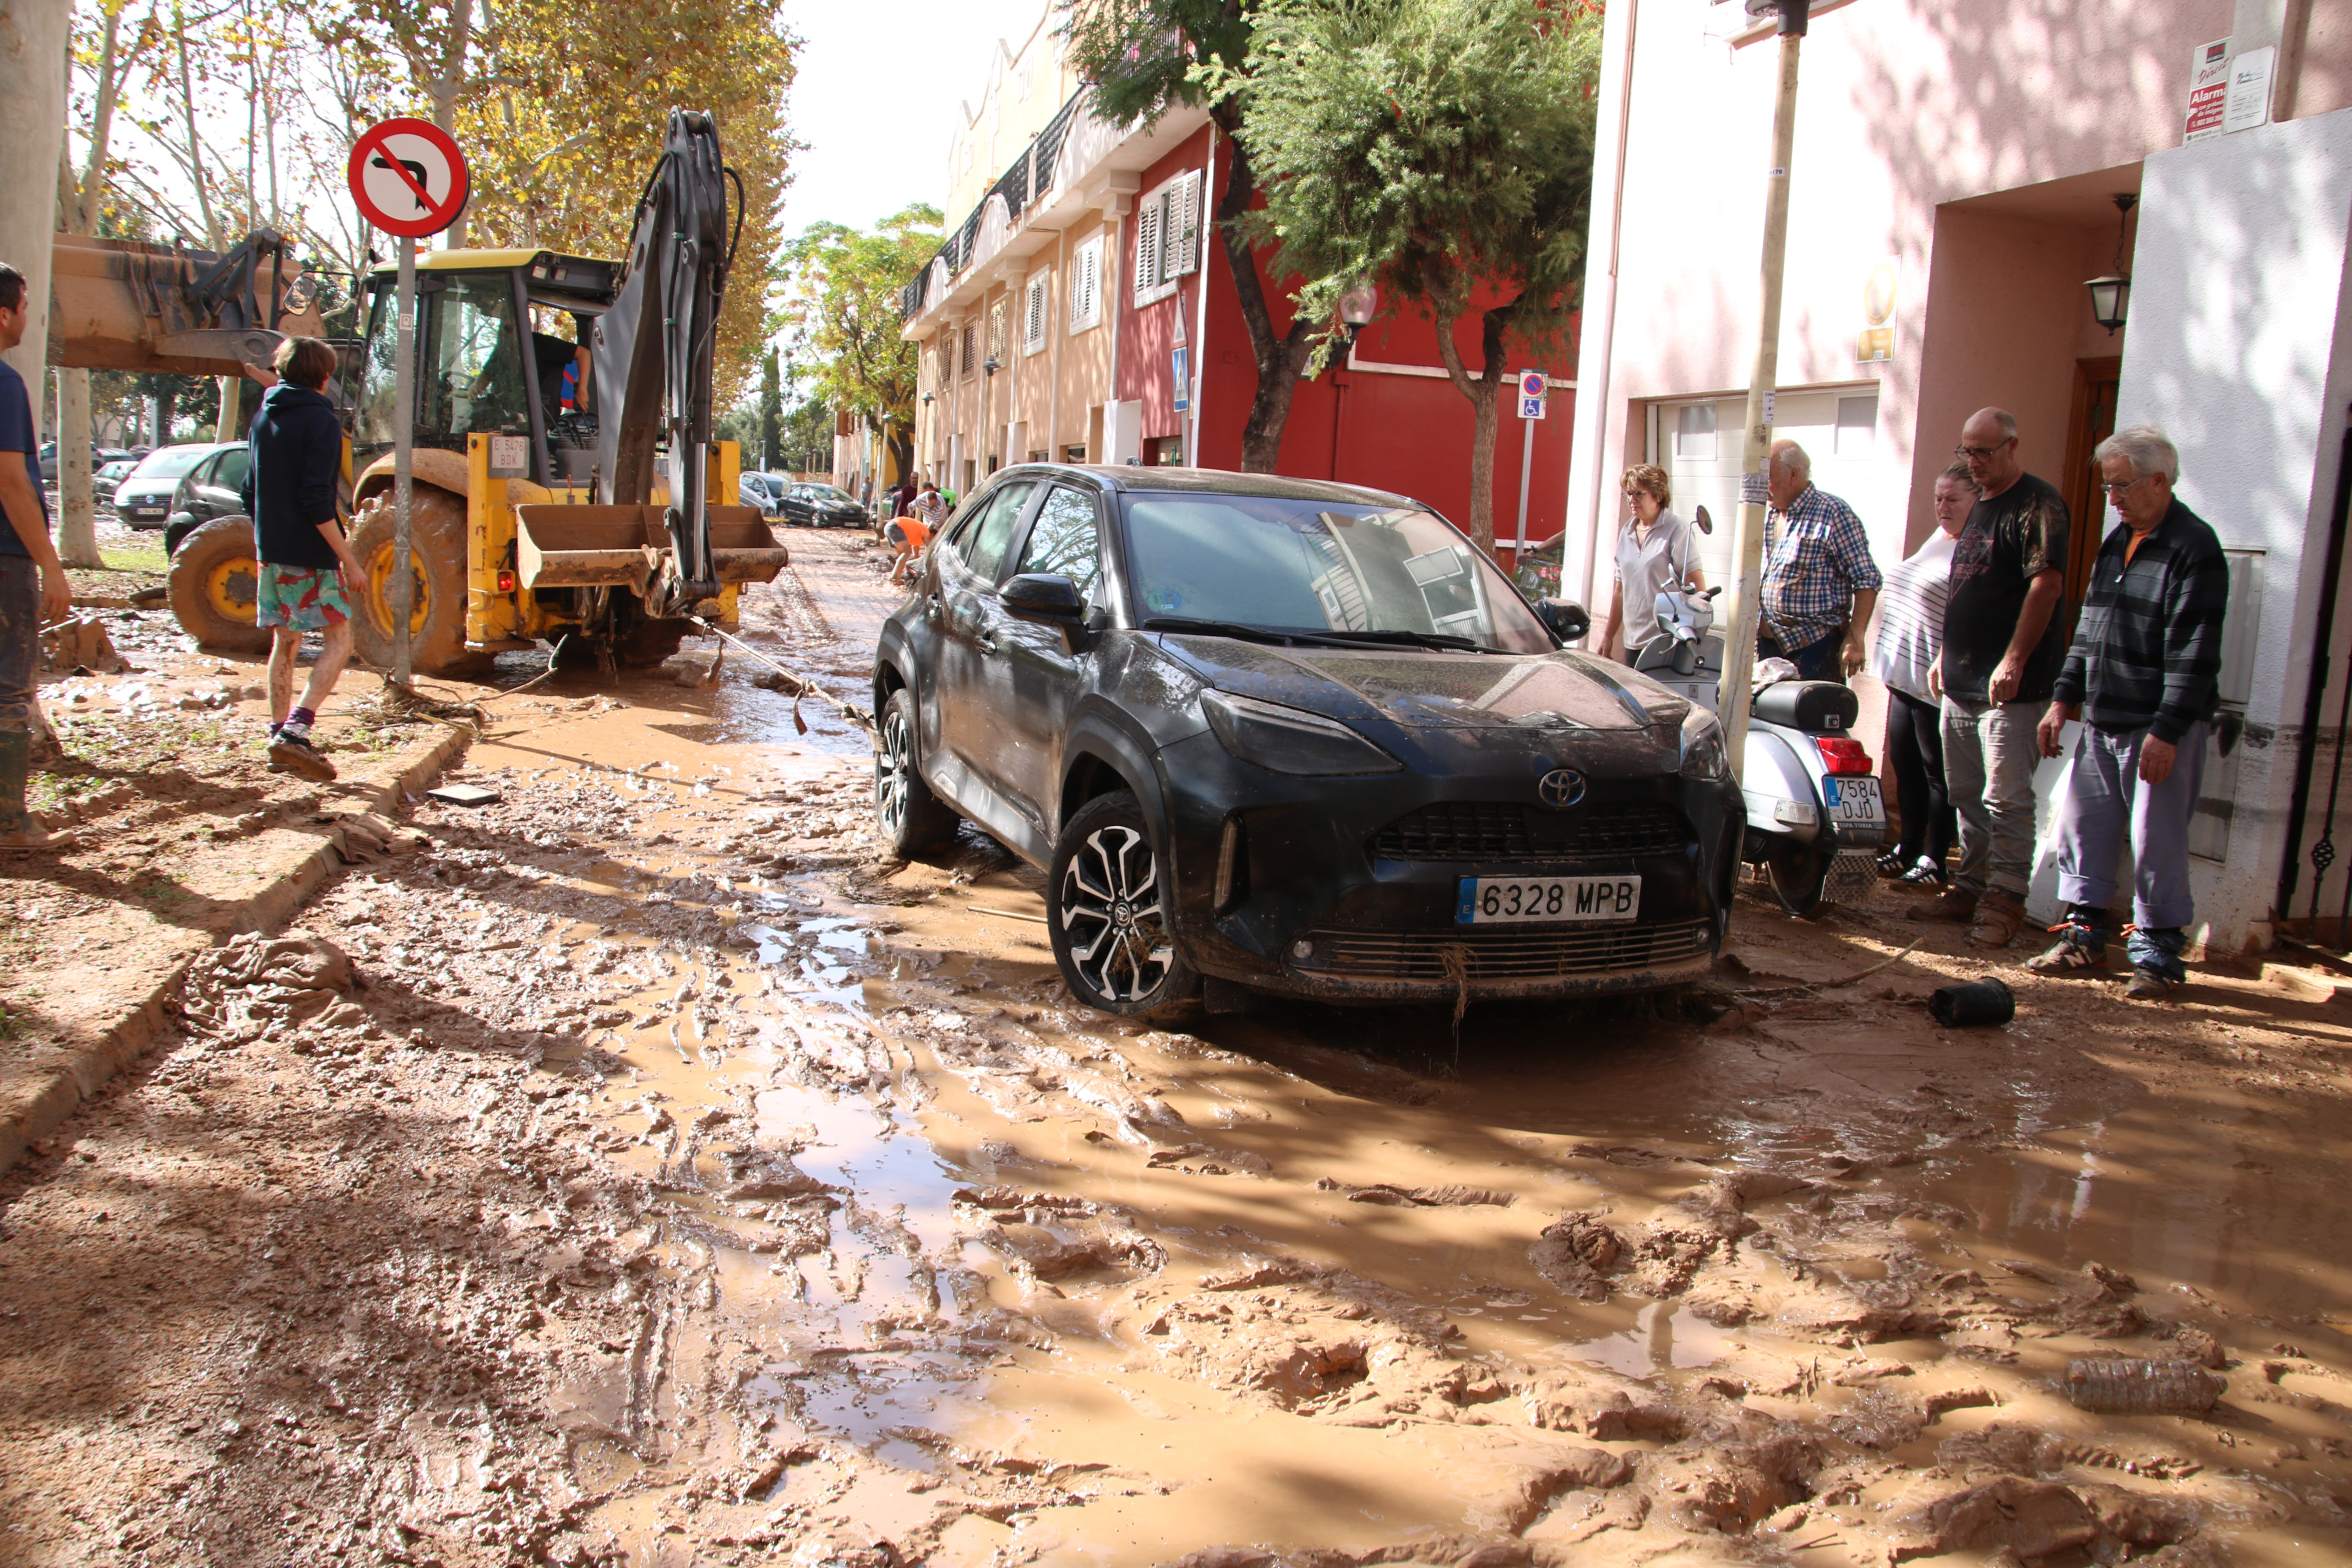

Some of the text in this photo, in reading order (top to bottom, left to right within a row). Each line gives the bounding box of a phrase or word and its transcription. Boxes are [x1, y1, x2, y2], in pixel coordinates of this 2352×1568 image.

[2198, 57, 2230, 84] Direct
[494, 439, 524, 451] E 5476
[501, 454, 516, 465] BDK
[1837, 780, 1877, 799] 7584
[1842, 801, 1874, 819] DJD
[1462, 882, 1633, 916] E 6328 MPB
